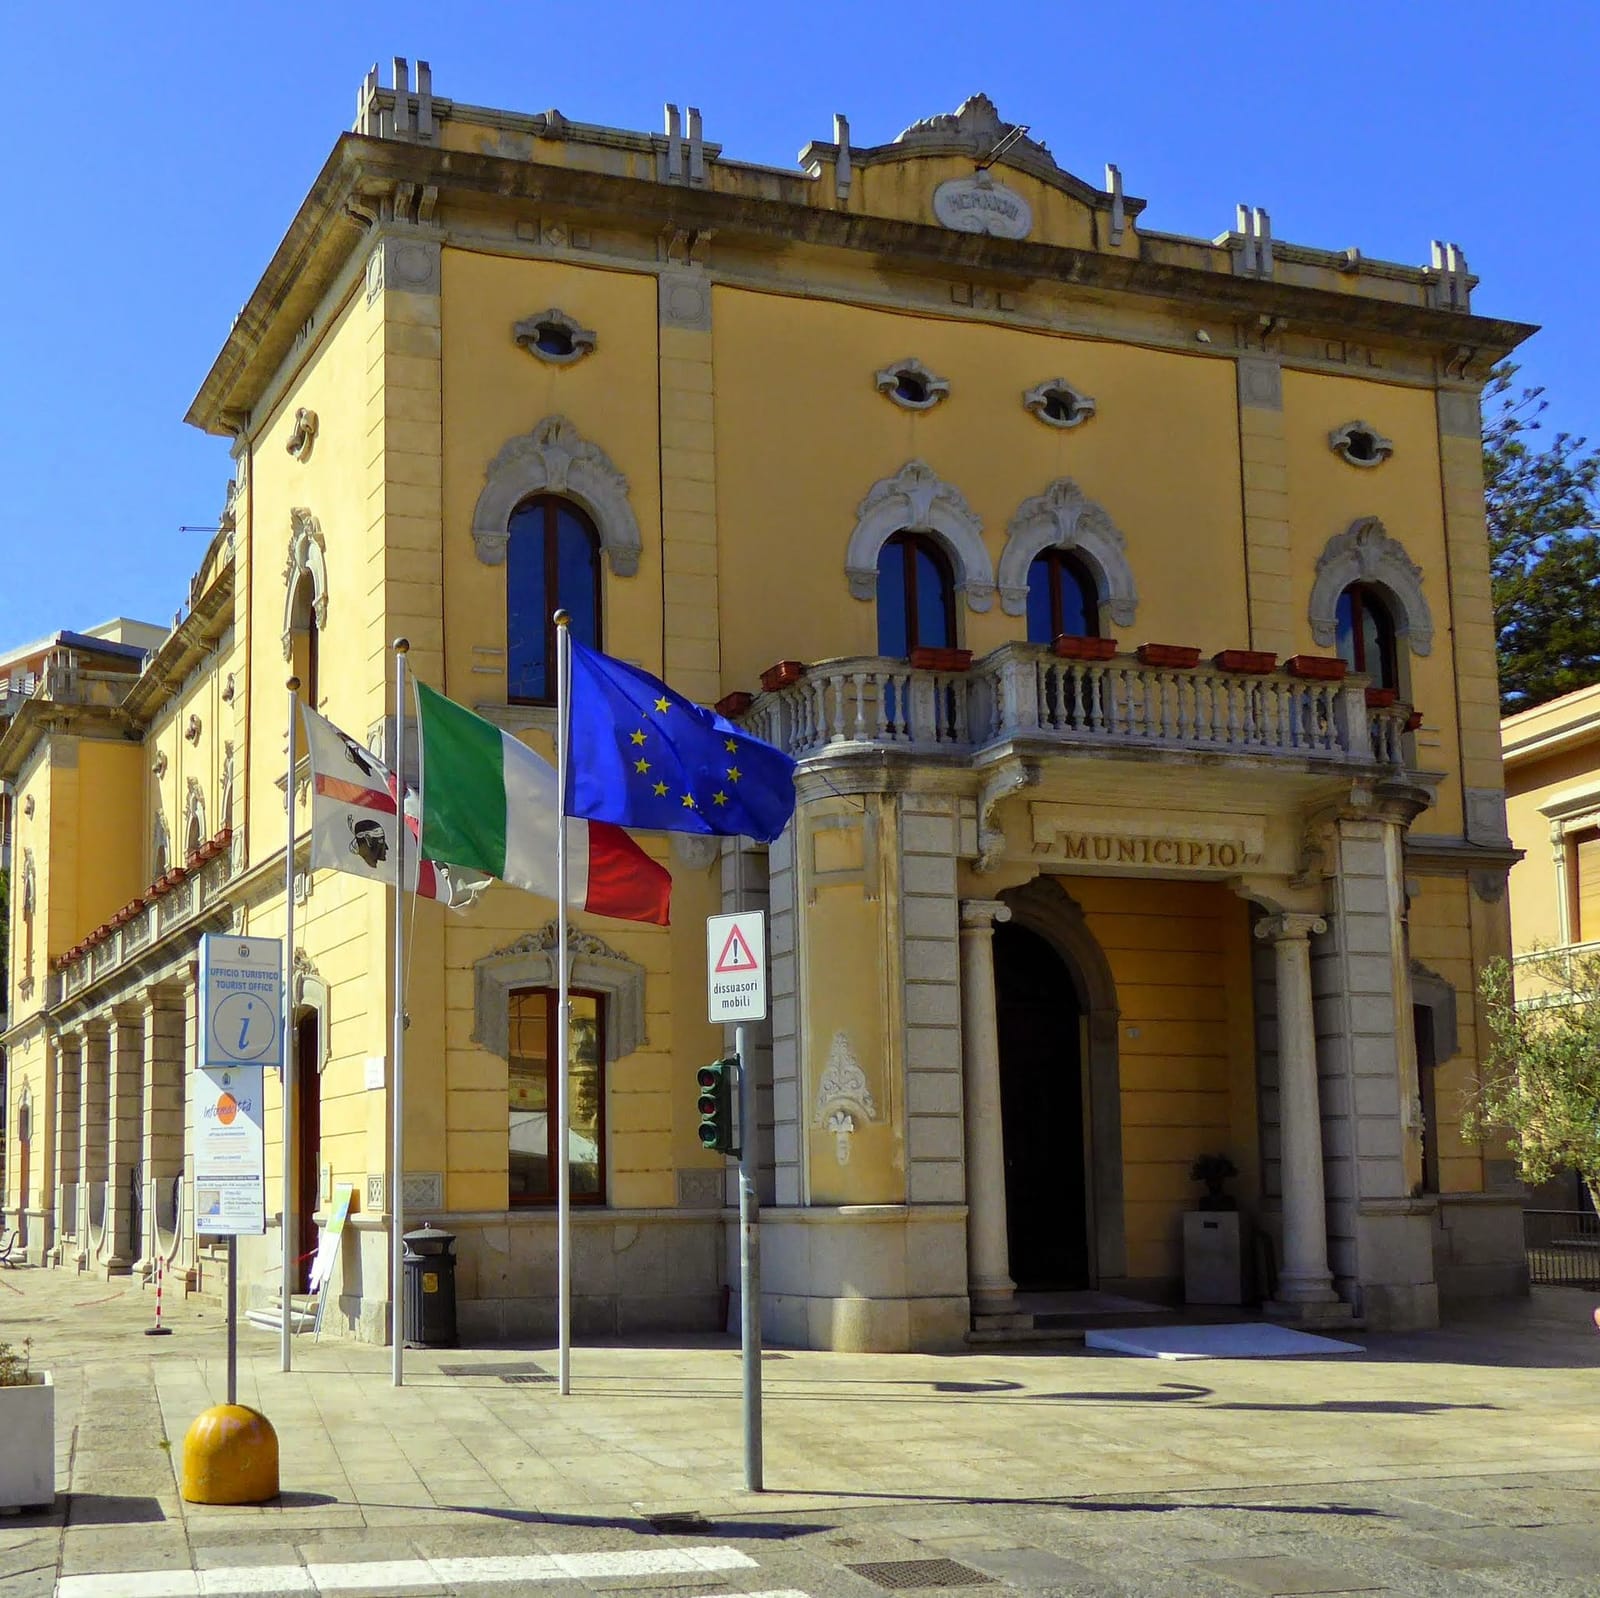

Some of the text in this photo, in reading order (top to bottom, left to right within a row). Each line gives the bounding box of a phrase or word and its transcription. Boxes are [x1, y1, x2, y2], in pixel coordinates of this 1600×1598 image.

[1064, 834, 1237, 867] MUNICIPIO
[211, 968, 279, 981] UFFICIO TURISTICO
[216, 980, 273, 992] TOURIST OFFICE
[713, 980, 758, 994] dissuasori
[721, 996, 750, 1008] mobili
